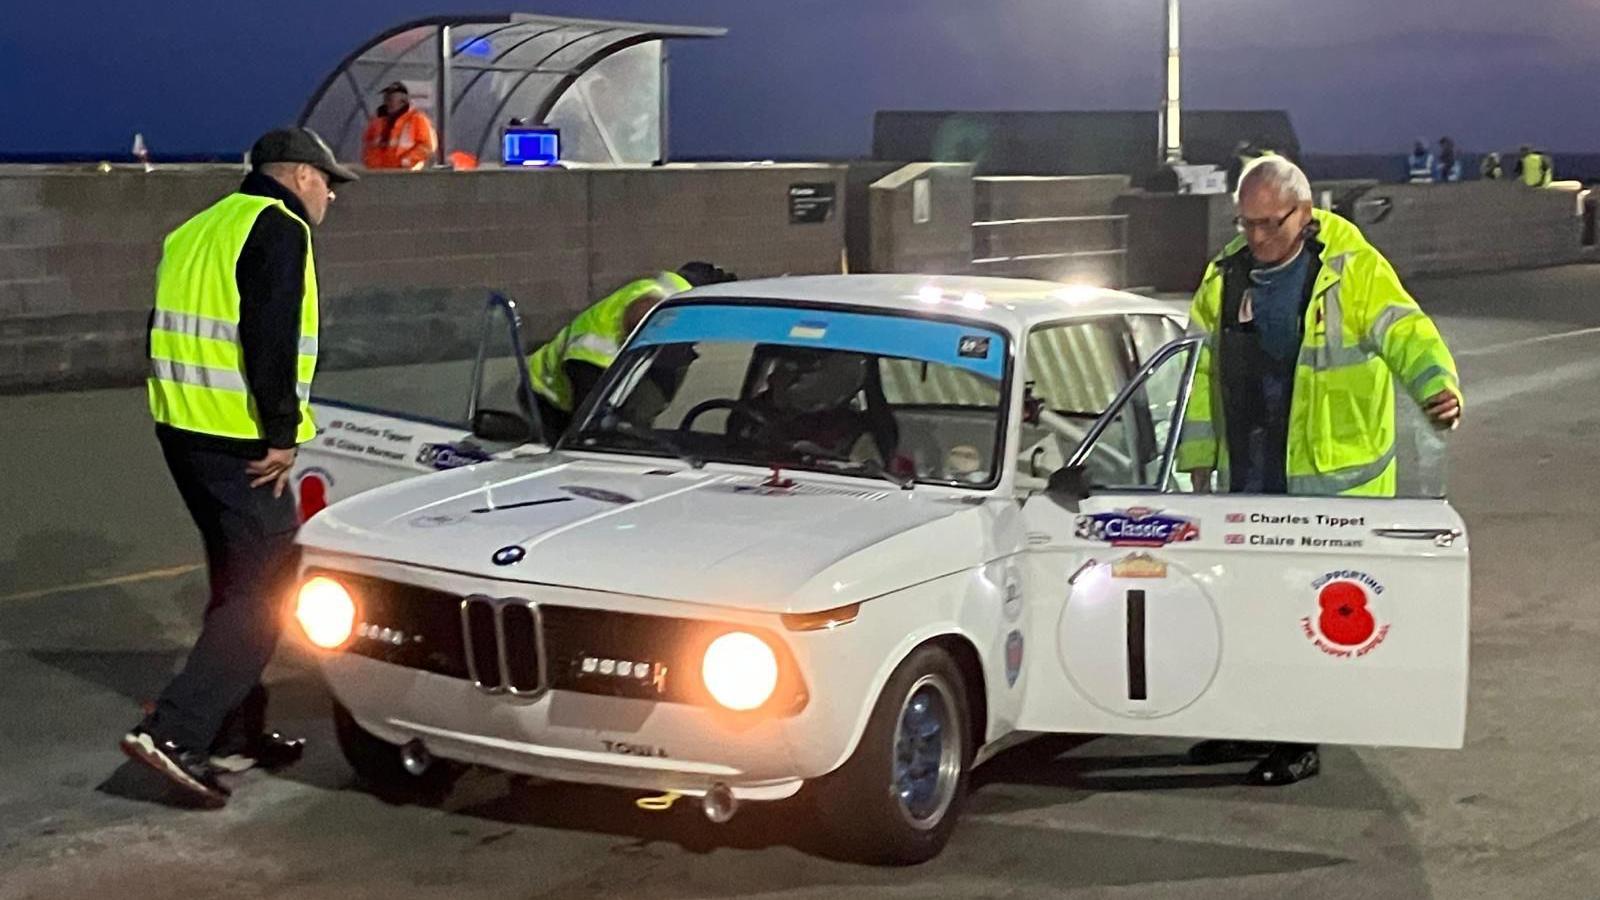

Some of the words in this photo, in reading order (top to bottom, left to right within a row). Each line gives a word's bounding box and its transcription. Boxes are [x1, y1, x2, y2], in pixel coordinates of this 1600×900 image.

[1105, 518, 1169, 538] Classic
[1250, 513, 1310, 525] Charles
[1315, 514, 1365, 527] Tippet
[1250, 534, 1295, 546] Claire
[1301, 536, 1363, 548] Norman
[1311, 569, 1385, 595] SUPPORTING
[1127, 589, 1147, 700] 1
